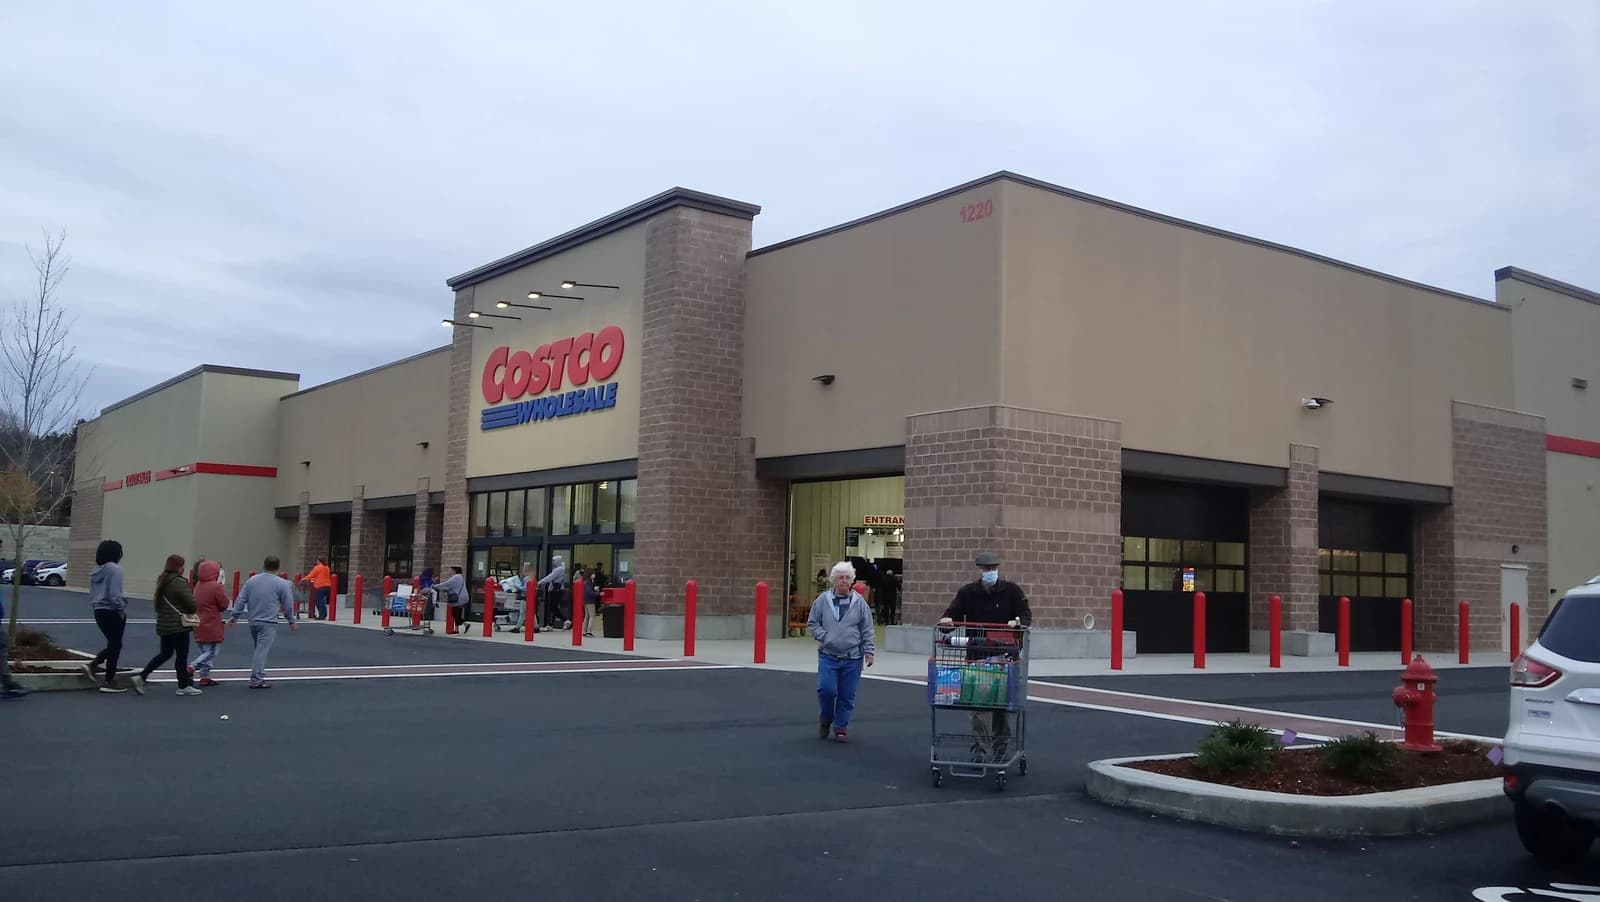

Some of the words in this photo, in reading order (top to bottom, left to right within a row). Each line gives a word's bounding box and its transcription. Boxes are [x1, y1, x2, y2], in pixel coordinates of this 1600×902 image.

[960, 199, 993, 224] 1220
[482, 325, 625, 404] COSTCO
[516, 382, 618, 425] WHOLESALE
[864, 516, 905, 524] ENTRAN
